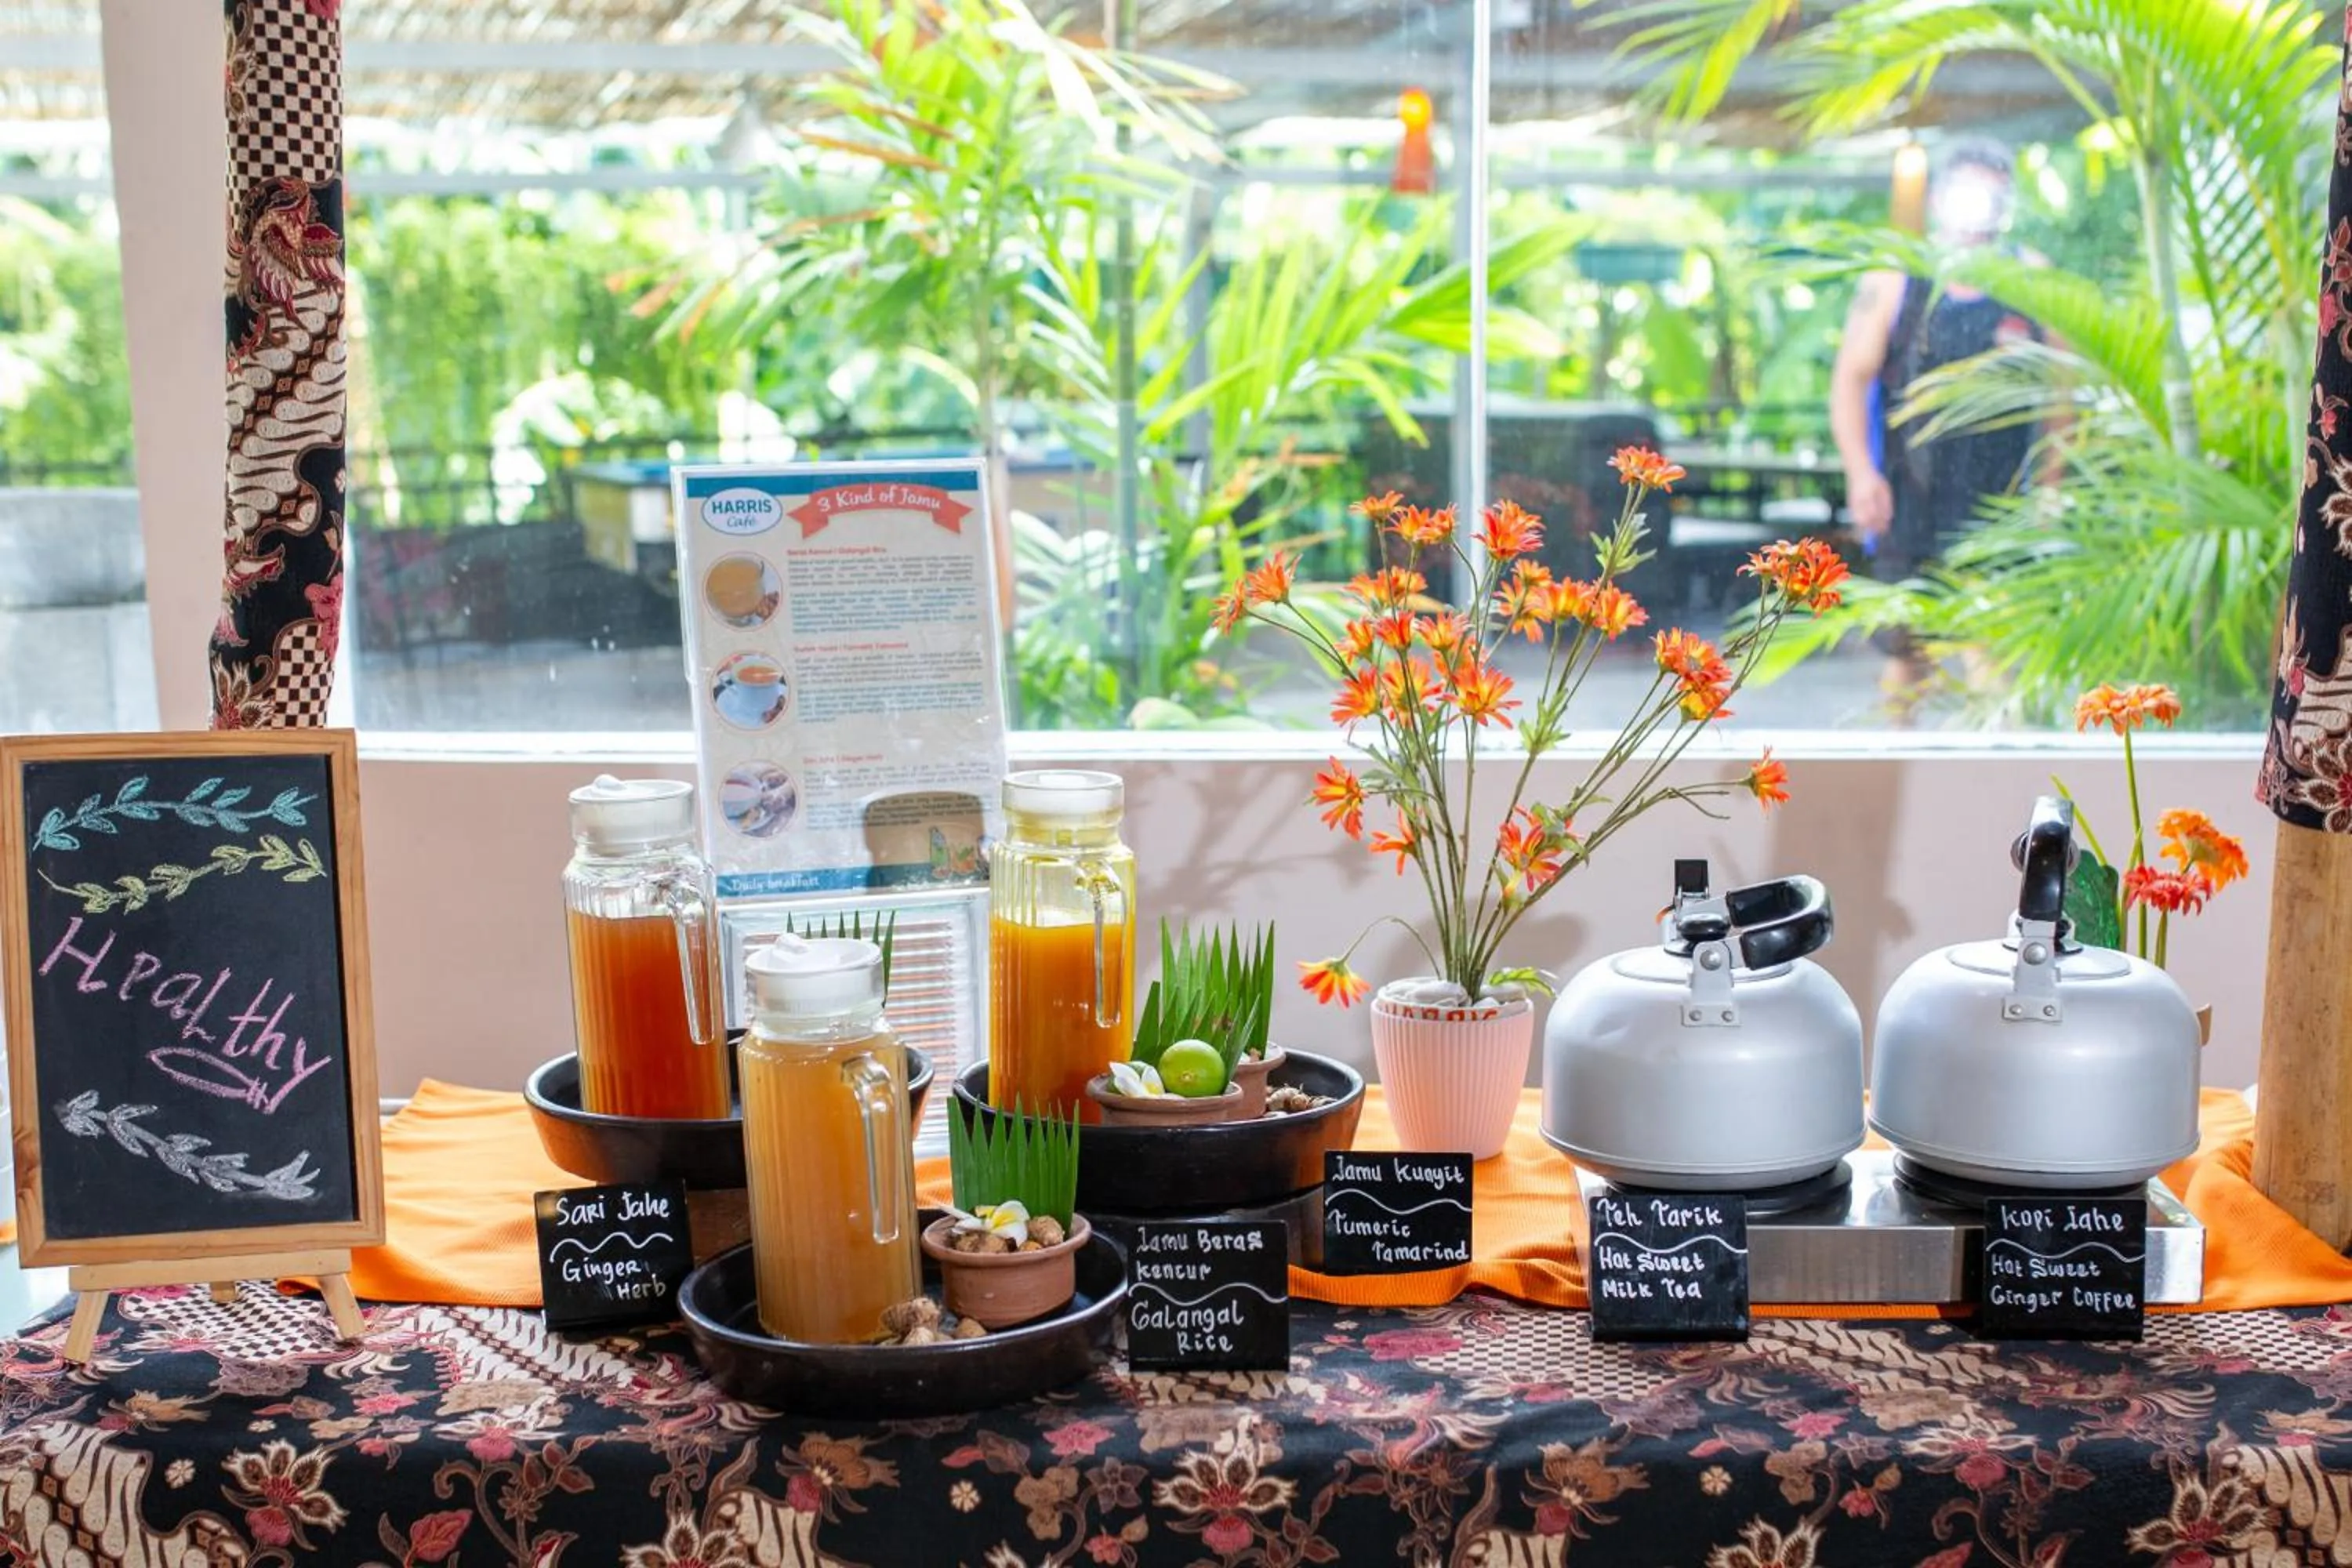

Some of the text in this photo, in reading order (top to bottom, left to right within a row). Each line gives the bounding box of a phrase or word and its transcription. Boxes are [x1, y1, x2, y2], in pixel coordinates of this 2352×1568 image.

[711, 499, 772, 514] HARRIS
[818, 485, 941, 512] 3 Kind of Jamu
[38, 916, 332, 1114] Healthy
[1333, 1156, 1382, 1181] Jamu
[617, 1191, 670, 1221] Jahe
[1596, 1198, 1722, 1227] Teh Tarik
[2063, 1206, 2125, 1231] Jahe
[1327, 1209, 1411, 1237] Tumeric
[1137, 1226, 1189, 1252] Jamu
[1372, 1240, 1469, 1263] Tamarind
[562, 1257, 641, 1284] Ginger
[1636, 1252, 1704, 1272] Sweet
[2029, 1258, 2100, 1279] Sweet
[616, 1272, 666, 1300] Herb
[1602, 1278, 1702, 1299] Milk Tea
[1990, 1285, 2136, 1313] Ginger Coffee
[1131, 1299, 1244, 1333] Galangal
[1177, 1331, 1233, 1355] Rice
